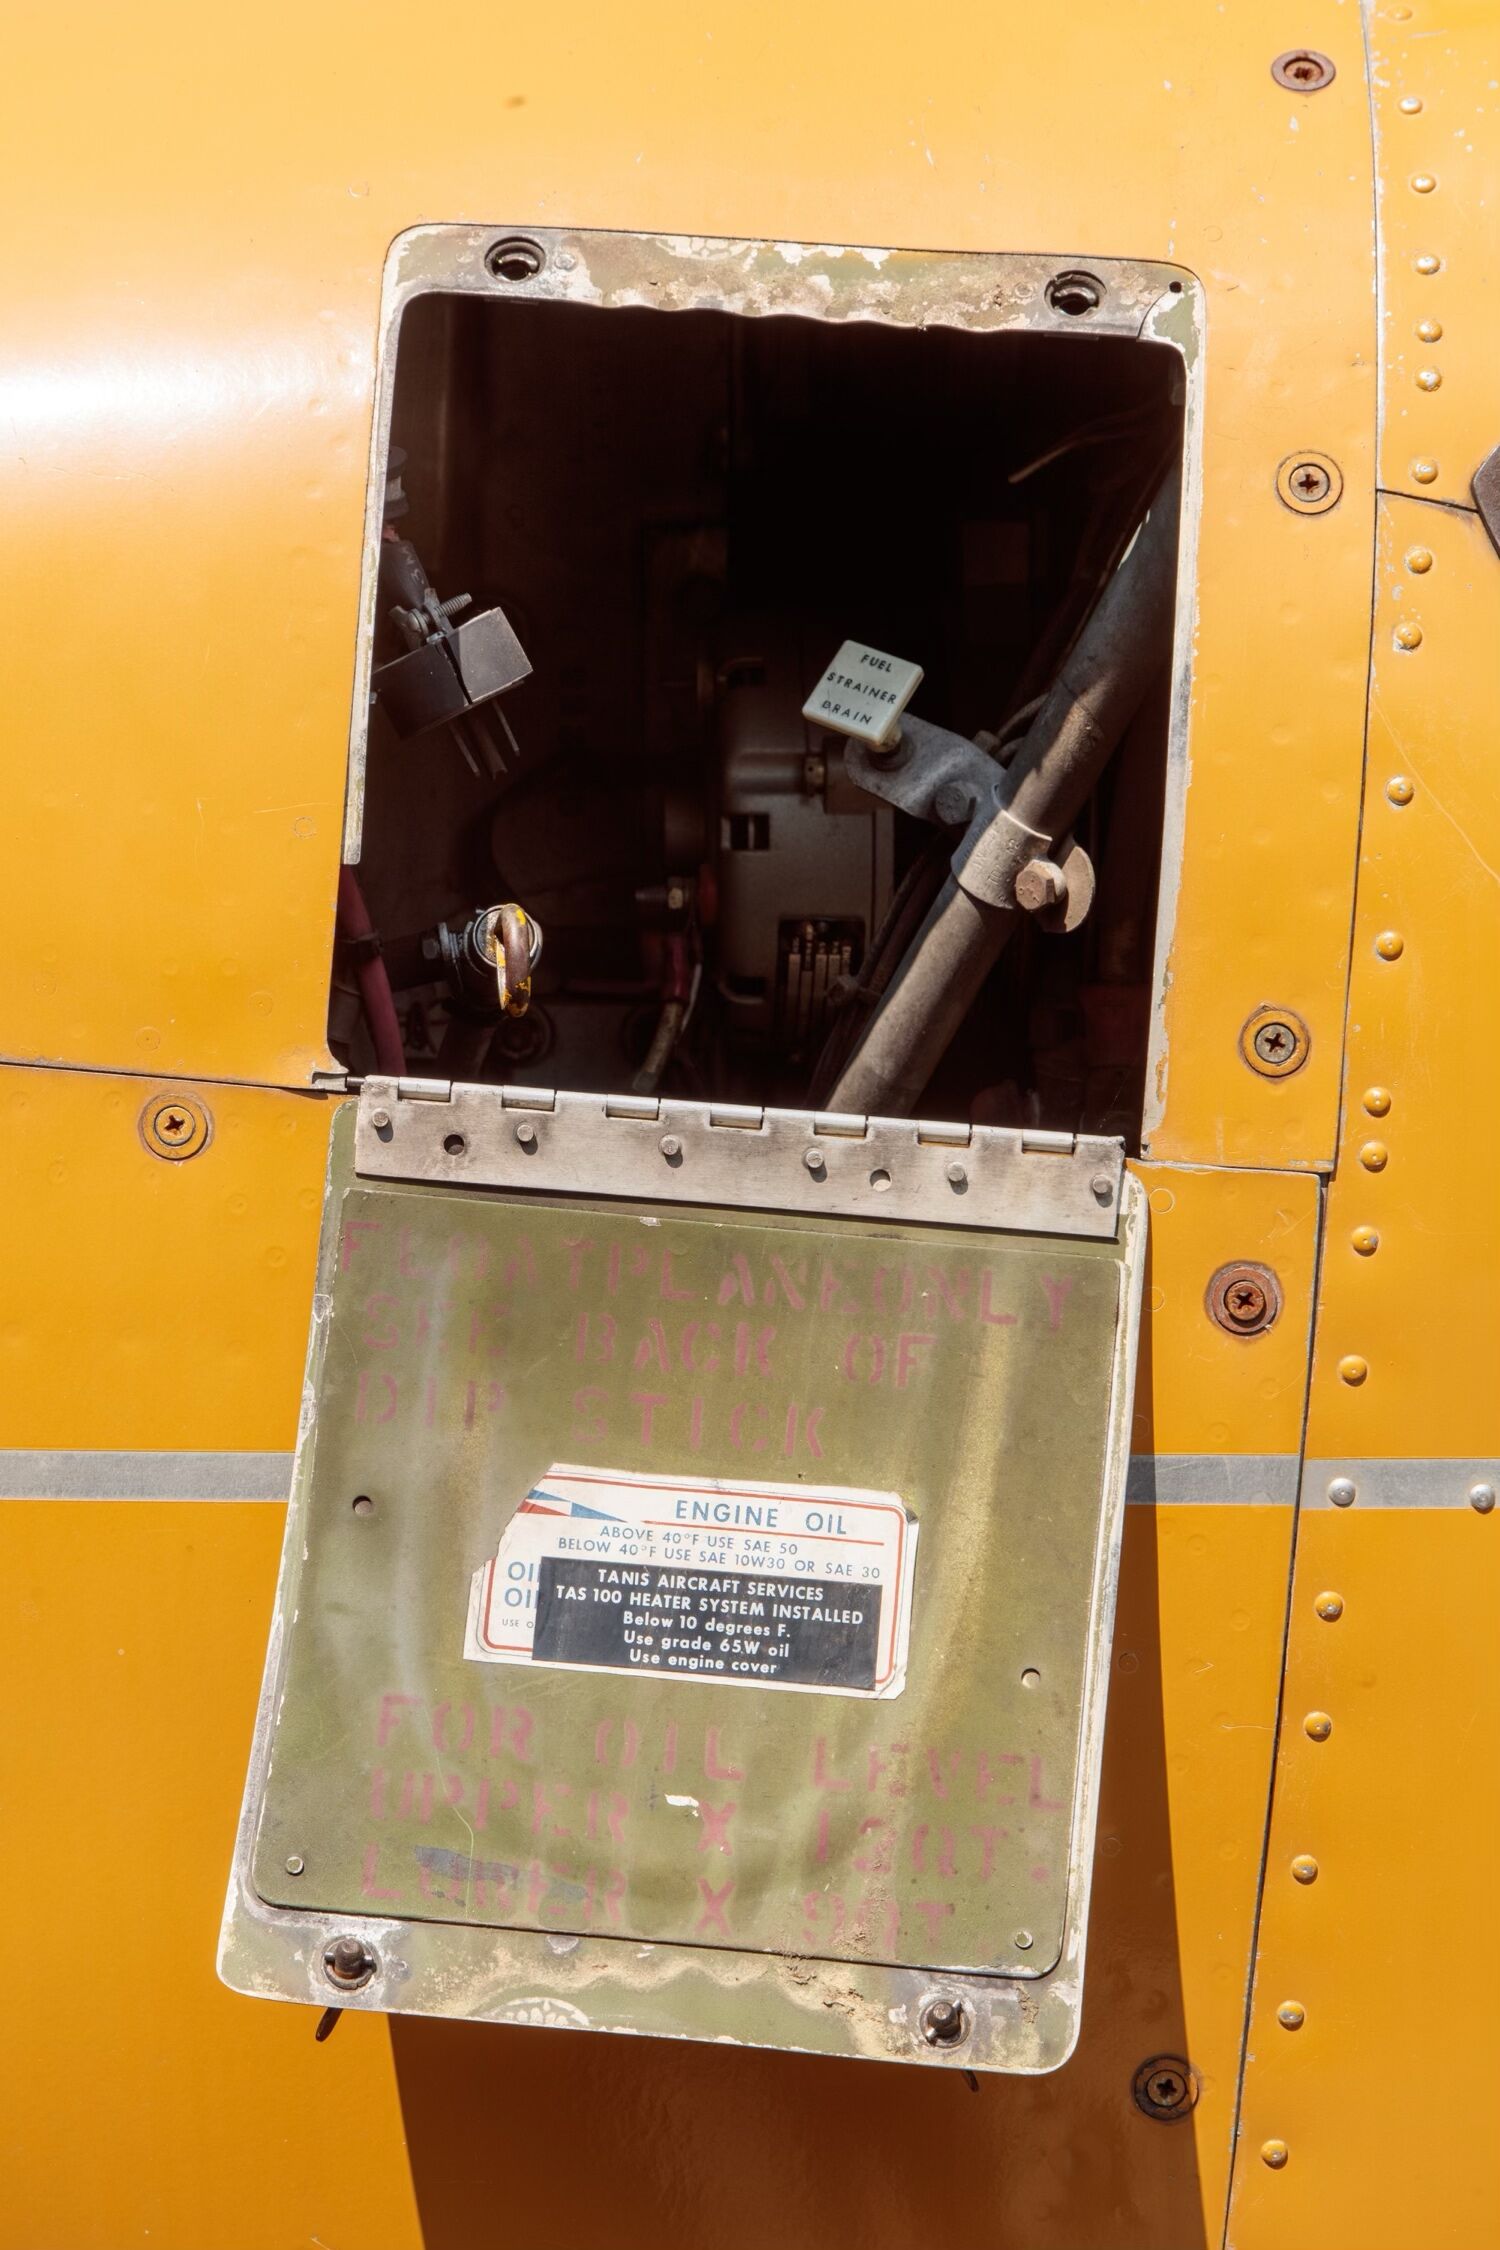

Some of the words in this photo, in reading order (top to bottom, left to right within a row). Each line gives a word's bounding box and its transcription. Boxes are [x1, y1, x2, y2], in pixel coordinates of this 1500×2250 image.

[860, 654, 892, 673] FUEL
[826, 672, 897, 704] STRAINER
[822, 700, 873, 725] DRAIN
[576, 1311, 776, 1378] BACK
[844, 1333, 938, 1389] OF
[571, 1386, 825, 1458] STICK
[675, 1499, 779, 1528] ENGINE
[805, 1512, 847, 1535] OIL
[600, 1526, 654, 1541] ABOVE
[707, 1536, 734, 1549] USE
[744, 1539, 770, 1553] SAE
[780, 1543, 798, 1555] 50
[558, 1537, 611, 1553] BELOW
[664, 1547, 691, 1561] USE
[699, 1551, 726, 1565] SAE
[735, 1554, 785, 1569] 10W30
[794, 1560, 815, 1573] OR
[825, 1562, 853, 1576] SAE
[862, 1566, 880, 1579] 30
[598, 1569, 650, 1586] TANIS
[657, 1575, 740, 1594] AIRCRAFT
[747, 1583, 824, 1601] SERVICES
[556, 1585, 587, 1601] TAS
[593, 1588, 622, 1604] 100
[630, 1592, 691, 1610] HEATER
[699, 1599, 764, 1617] SYSTEM
[772, 1604, 864, 1625] INSTALLED
[502, 1618, 519, 1628] USE
[623, 1611, 673, 1628] Below
[680, 1615, 697, 1629] 10
[705, 1619, 770, 1637] degrees
[777, 1625, 790, 1637] F.
[624, 1630, 653, 1646] Use
[661, 1634, 711, 1651] grade
[768, 1643, 789, 1657] oil
[629, 1648, 660, 1664] Use
[668, 1654, 725, 1670] engine
[731, 1659, 777, 1674] cover
[375, 1690, 534, 1762] FOR
[595, 1717, 747, 1782] OIL
[811, 1736, 1068, 1813] LEVEL
[370, 1766, 630, 1844] UPPER
[697, 1800, 738, 1857] X
[694, 1876, 738, 1937] X
